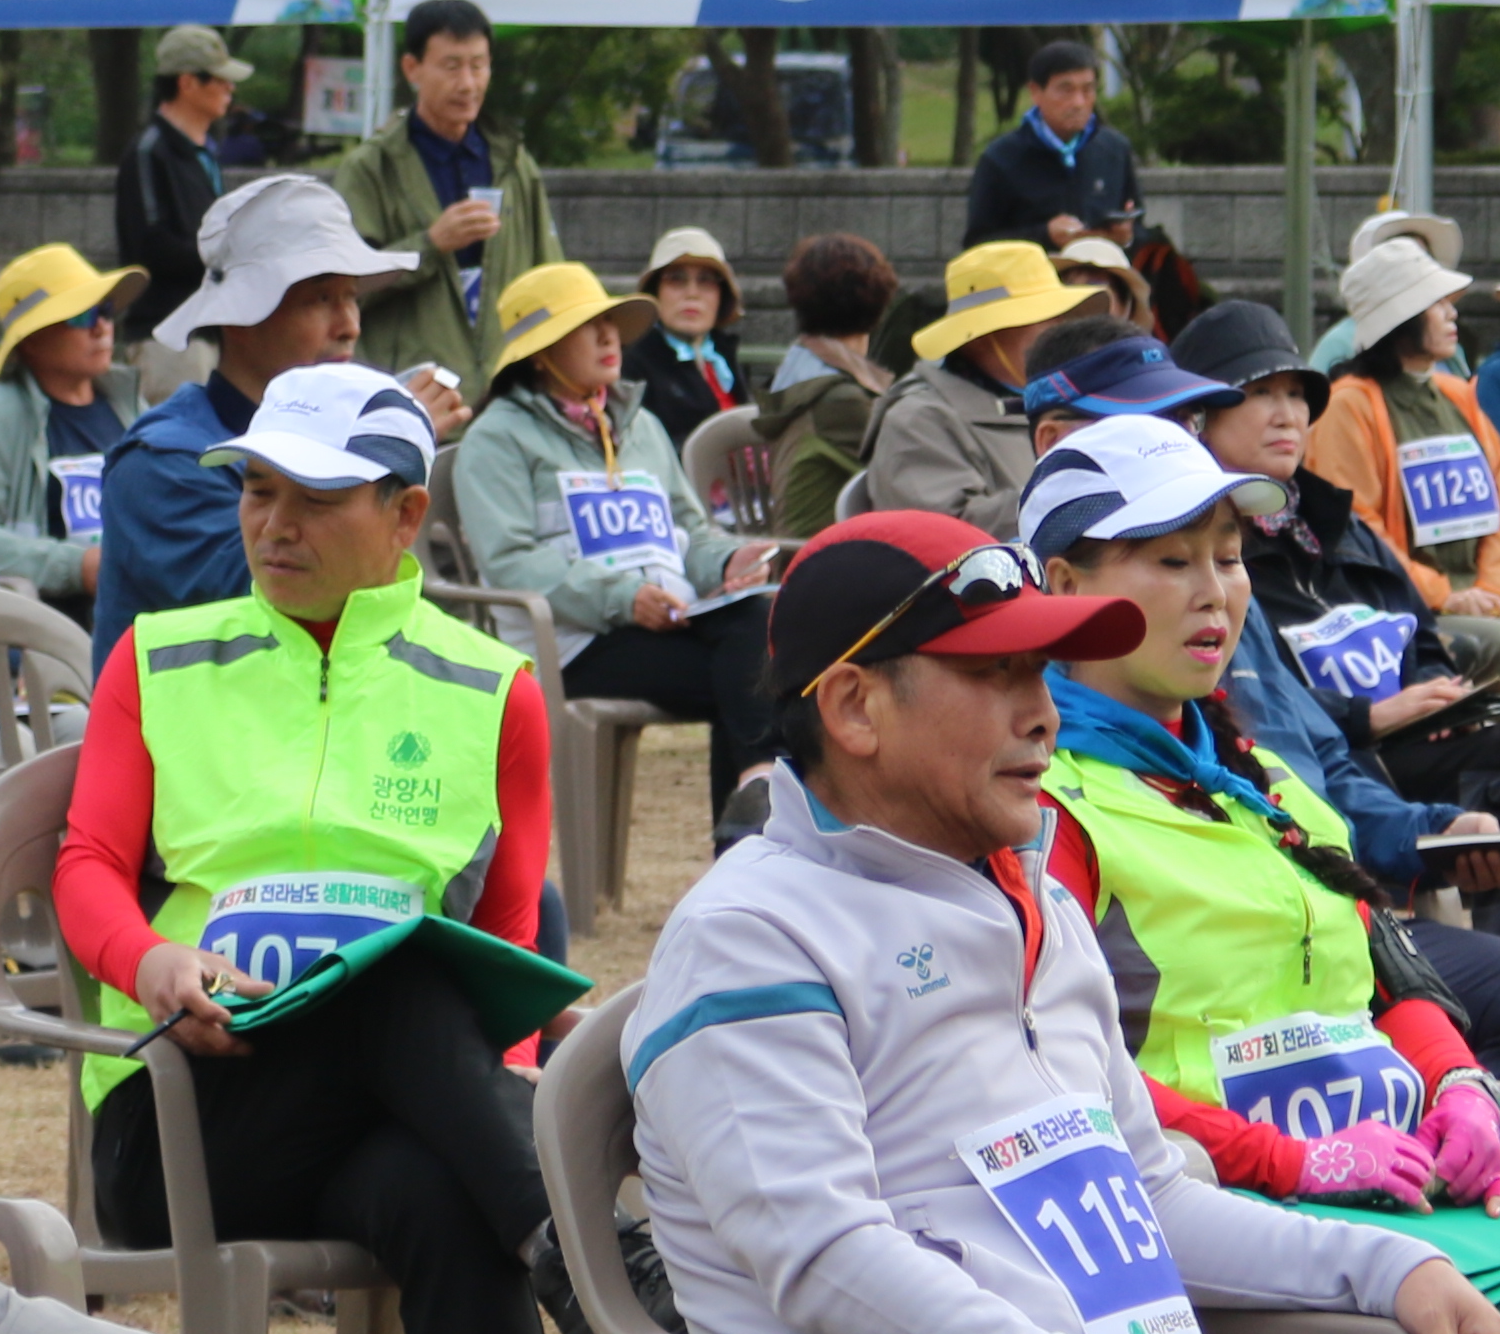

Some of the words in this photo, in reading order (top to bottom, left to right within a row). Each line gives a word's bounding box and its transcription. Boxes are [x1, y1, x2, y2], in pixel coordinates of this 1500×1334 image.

[1412, 466, 1491, 511] 112-B
[577, 498, 669, 540] 102-B
[372, 774, 442, 804] 광양시
[369, 800, 440, 828] 산악연맹
[260, 882, 320, 904] 전라남도
[322, 882, 412, 915] 생활체육대축전
[906, 973, 951, 999] hummel
[1225, 1032, 1279, 1065] 제37회
[976, 1128, 1041, 1175] 제37회
[1031, 1108, 1094, 1150] 전라남도
